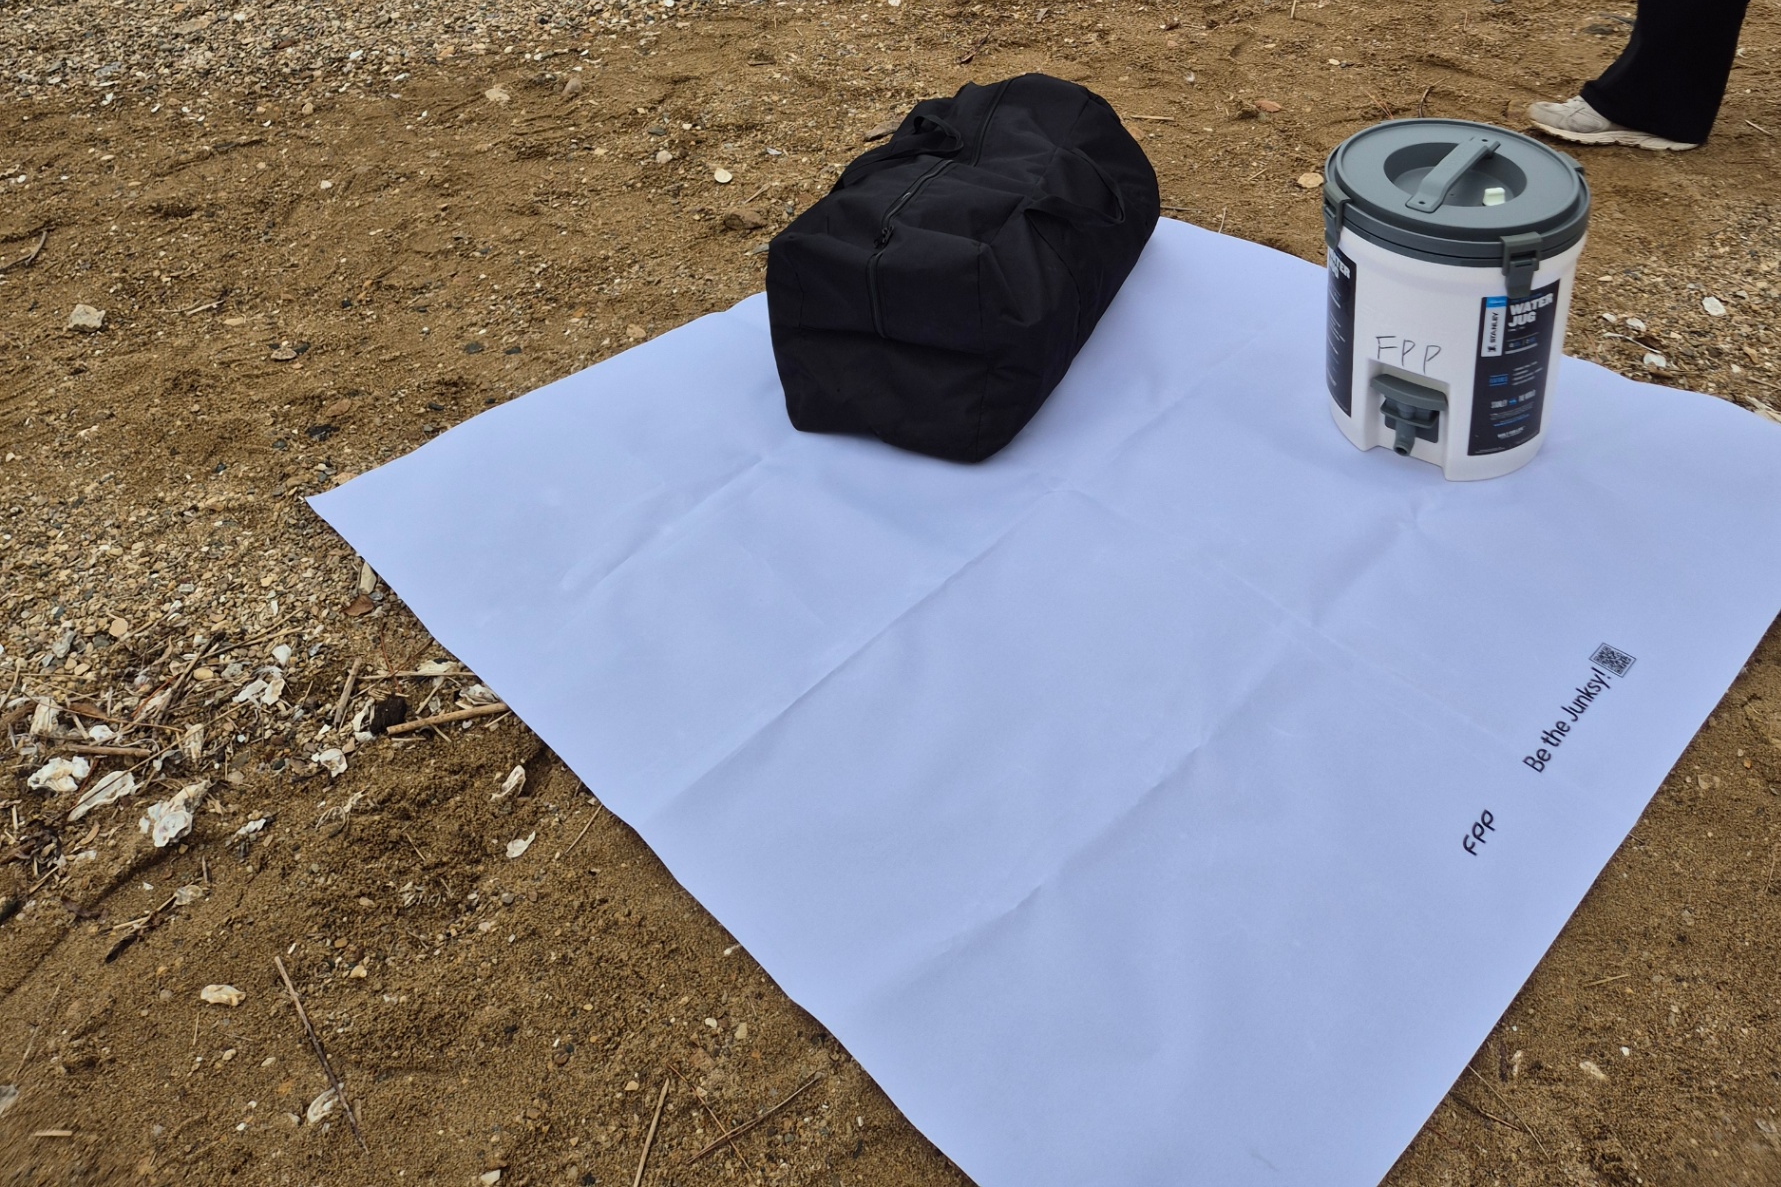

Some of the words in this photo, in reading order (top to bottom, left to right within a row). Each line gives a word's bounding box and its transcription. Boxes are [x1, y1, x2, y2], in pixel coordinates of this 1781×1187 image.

[1507, 311, 1537, 328] JUG
[1509, 292, 1554, 316] WATER
[1489, 312, 1500, 344] STANLEY
[1375, 335, 1442, 375] FPP
[1522, 748, 1552, 773] Be
[1540, 720, 1571, 747] the
[1560, 666, 1612, 723] Junksy!
